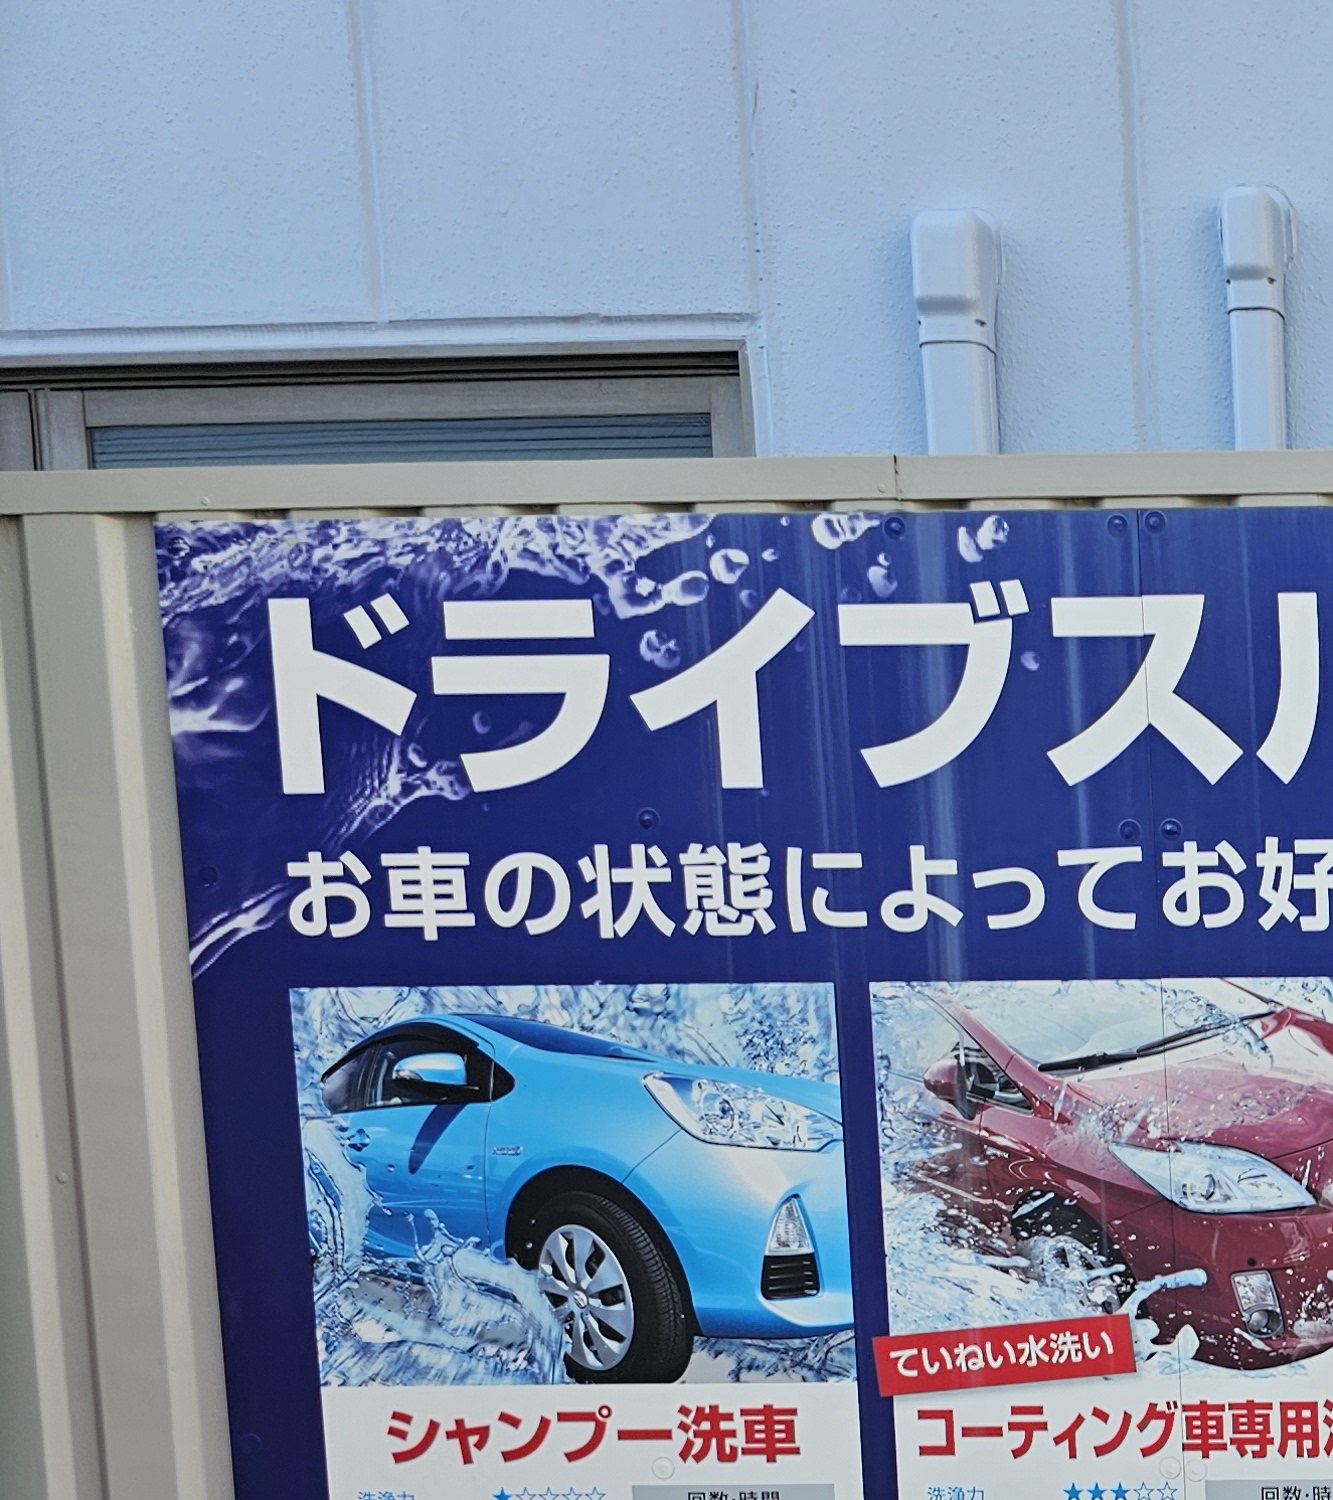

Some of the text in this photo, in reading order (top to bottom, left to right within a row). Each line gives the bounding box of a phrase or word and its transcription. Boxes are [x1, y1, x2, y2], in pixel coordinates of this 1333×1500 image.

[889, 1331, 1114, 1378] ていねい水洗い
[386, 1403, 801, 1466] シャンプー洗車
